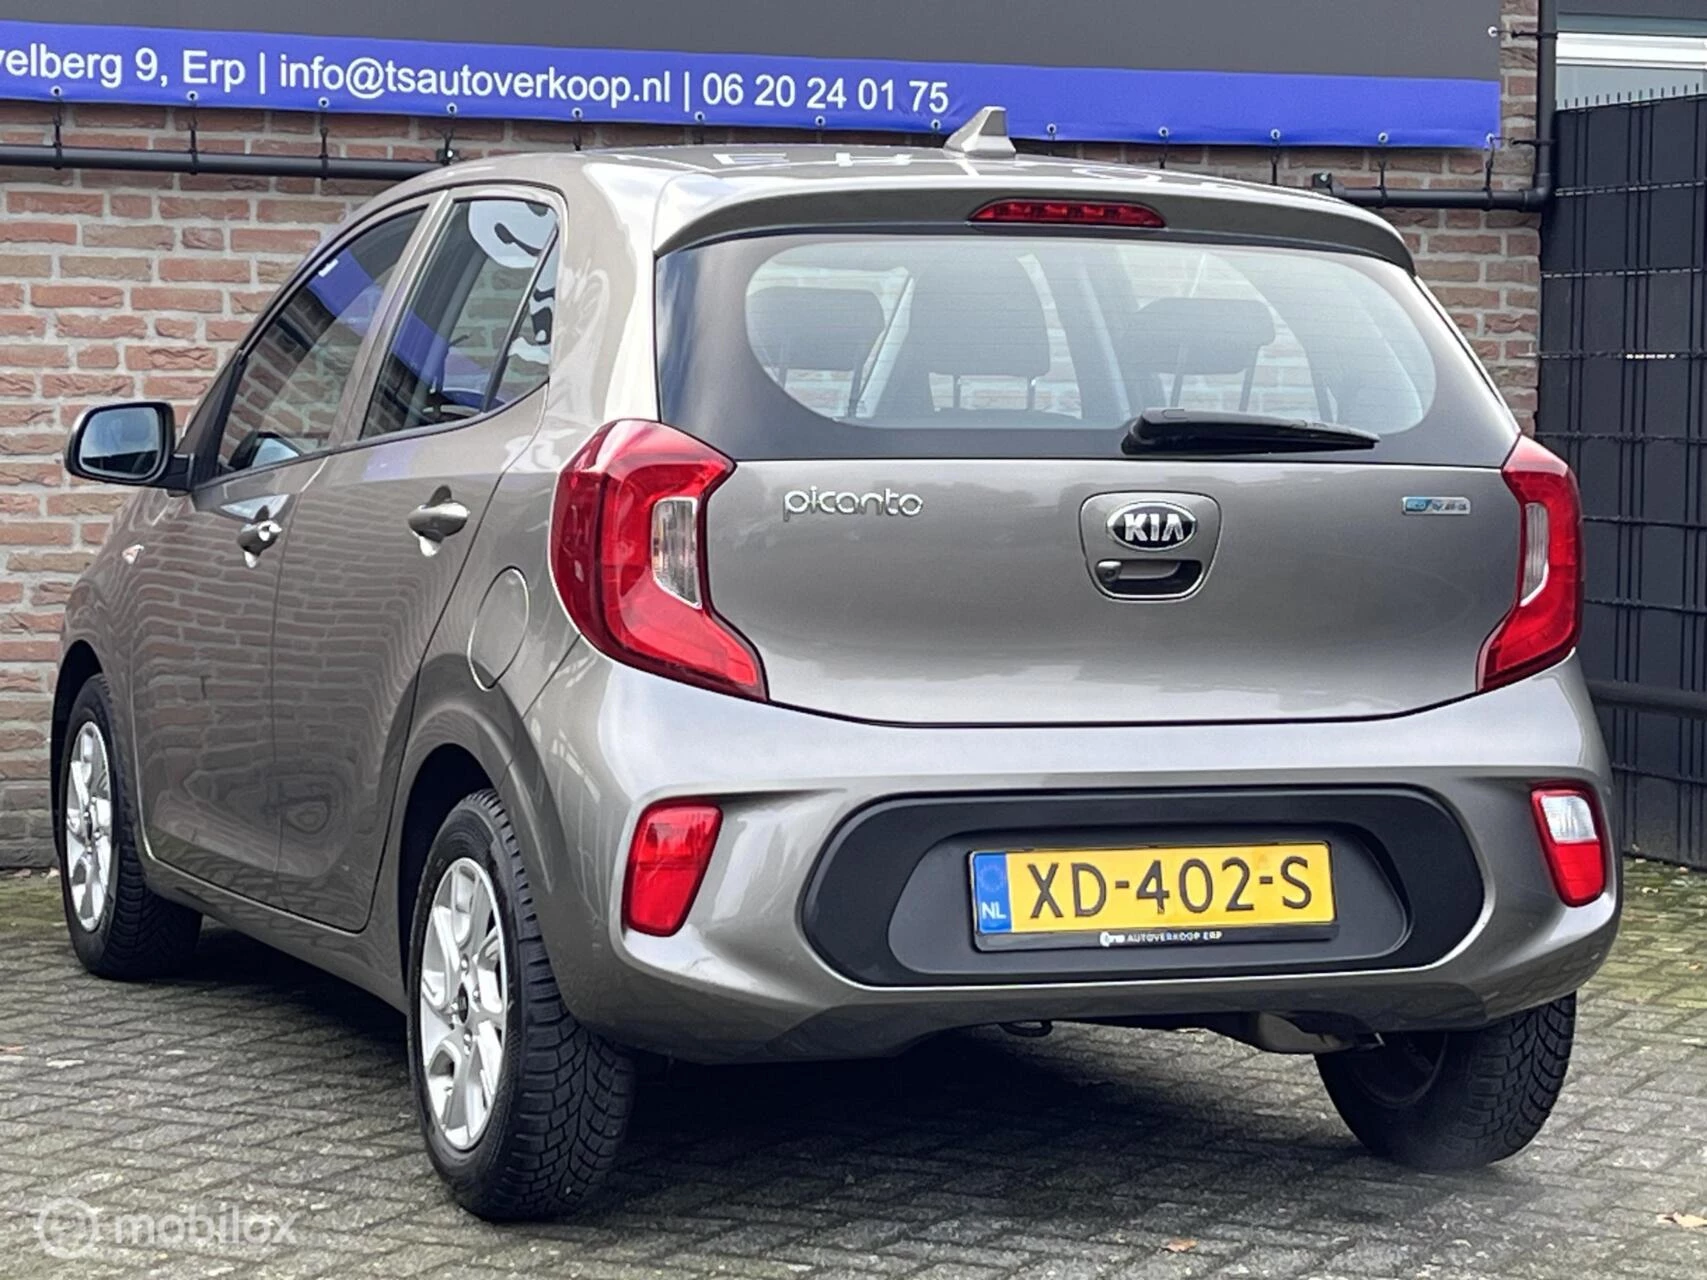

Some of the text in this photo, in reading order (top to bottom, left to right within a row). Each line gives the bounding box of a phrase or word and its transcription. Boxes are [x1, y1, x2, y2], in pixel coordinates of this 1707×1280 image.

[0, 42, 122, 89] elberg
[135, 47, 168, 87] 9,
[182, 49, 246, 93] Erp
[279, 55, 671, 109] info@tsautoverkoop.nl
[702, 72, 744, 106] 06
[754, 74, 796, 107] 20
[806, 77, 847, 109] 24
[858, 78, 894, 111] 01
[909, 80, 949, 113] 75
[783, 485, 923, 522] picanto
[1124, 512, 1185, 542] KIA
[1026, 854, 1313, 919] XD-402-S
[981, 901, 1007, 920] NL
